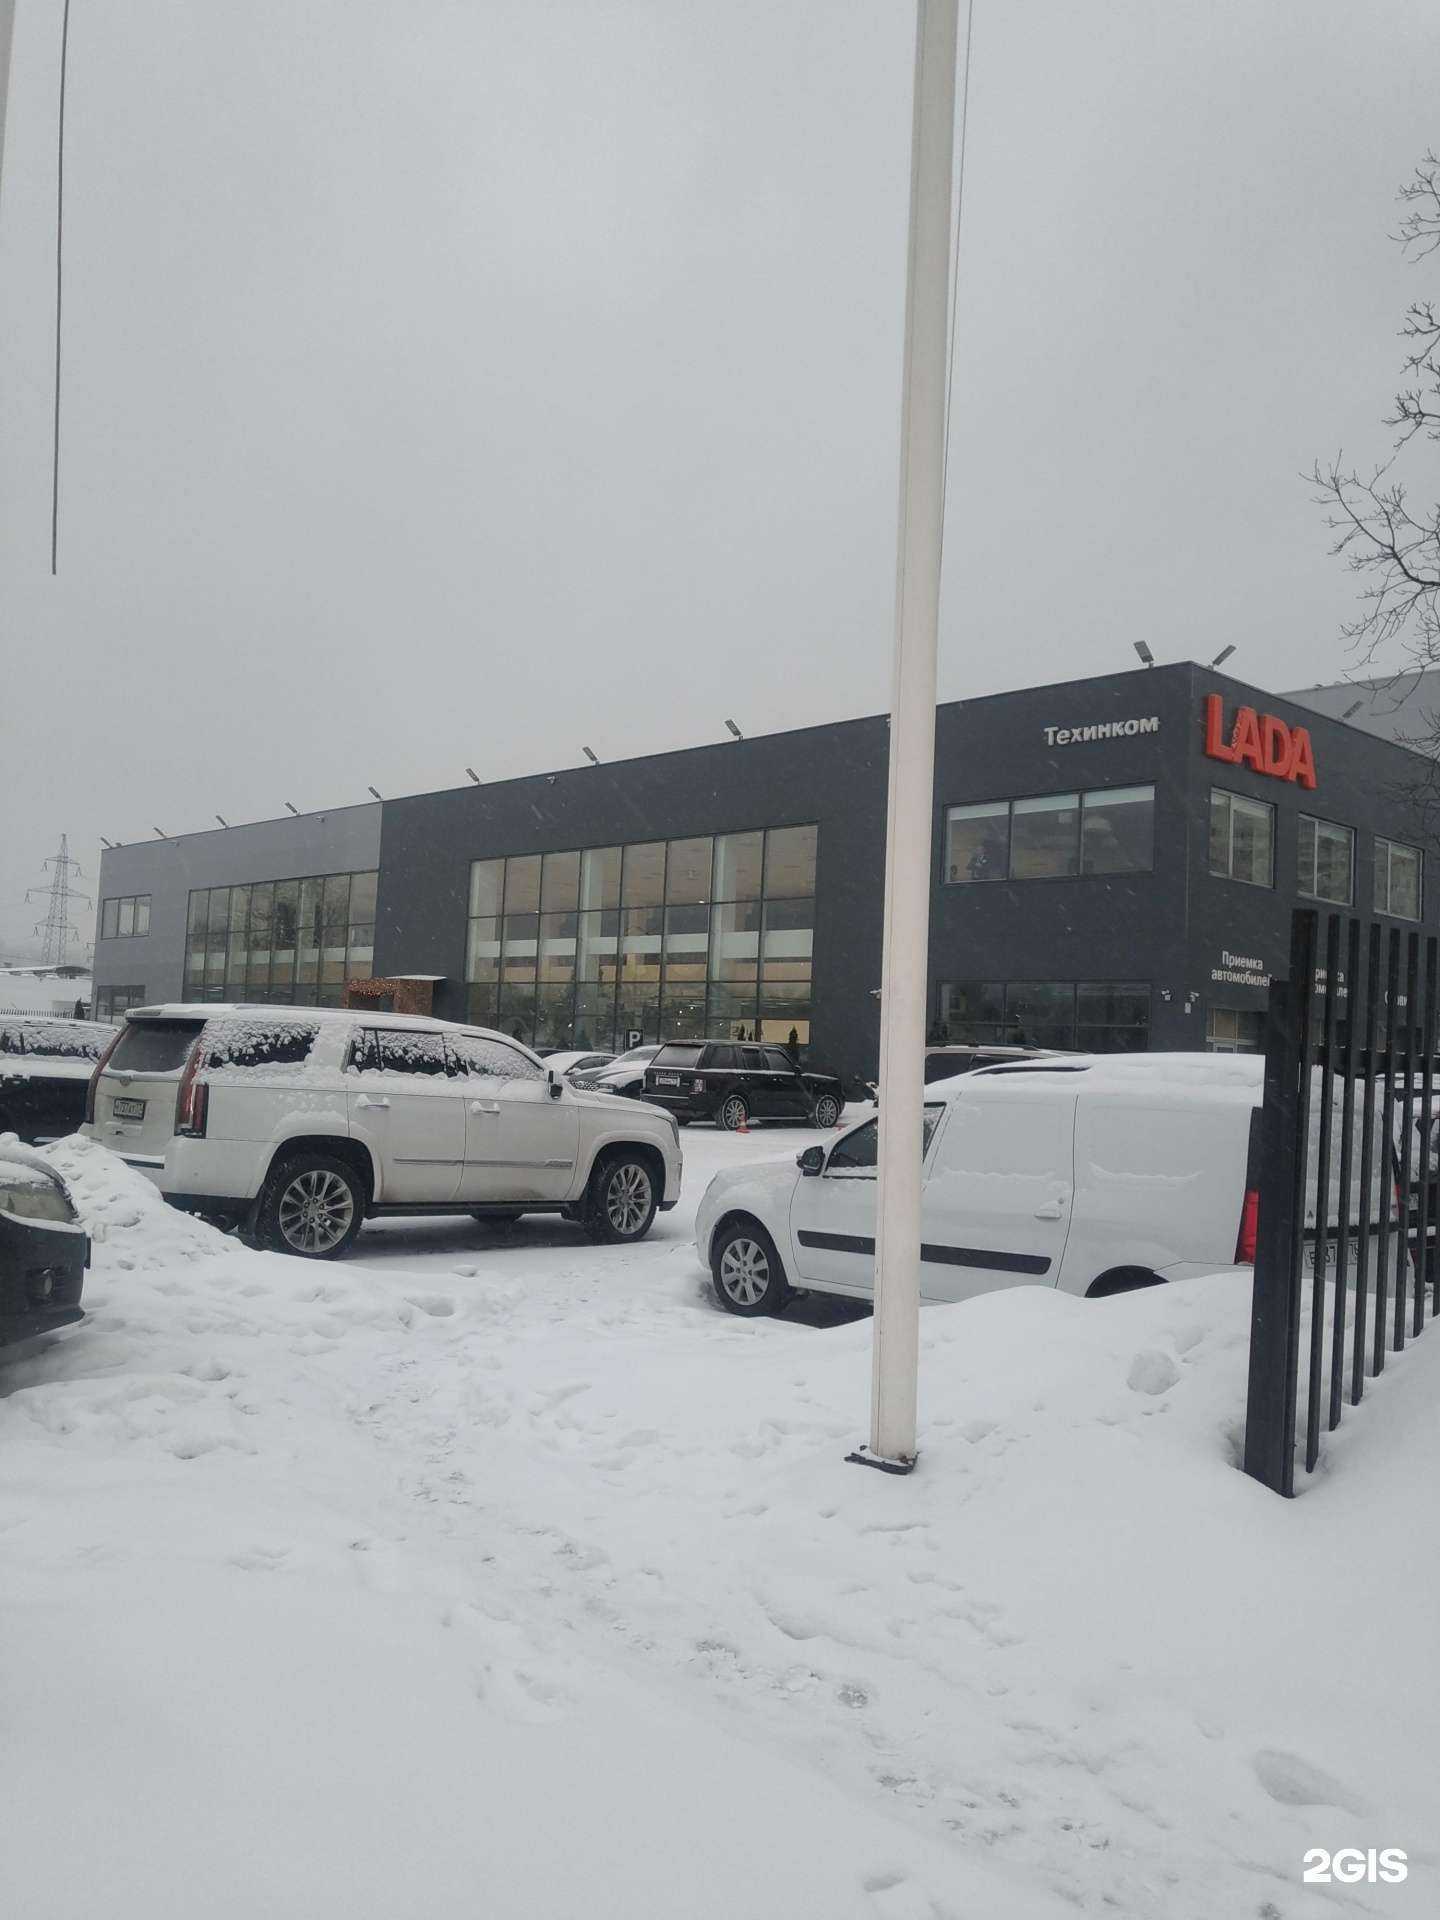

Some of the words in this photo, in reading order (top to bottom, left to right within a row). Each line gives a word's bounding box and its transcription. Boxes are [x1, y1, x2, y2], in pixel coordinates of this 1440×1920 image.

[1043, 716, 1160, 746] Техинком
[1206, 693, 1317, 790] LADA
[1222, 950, 1264, 970] Приемка
[629, 1031, 641, 1048] P
